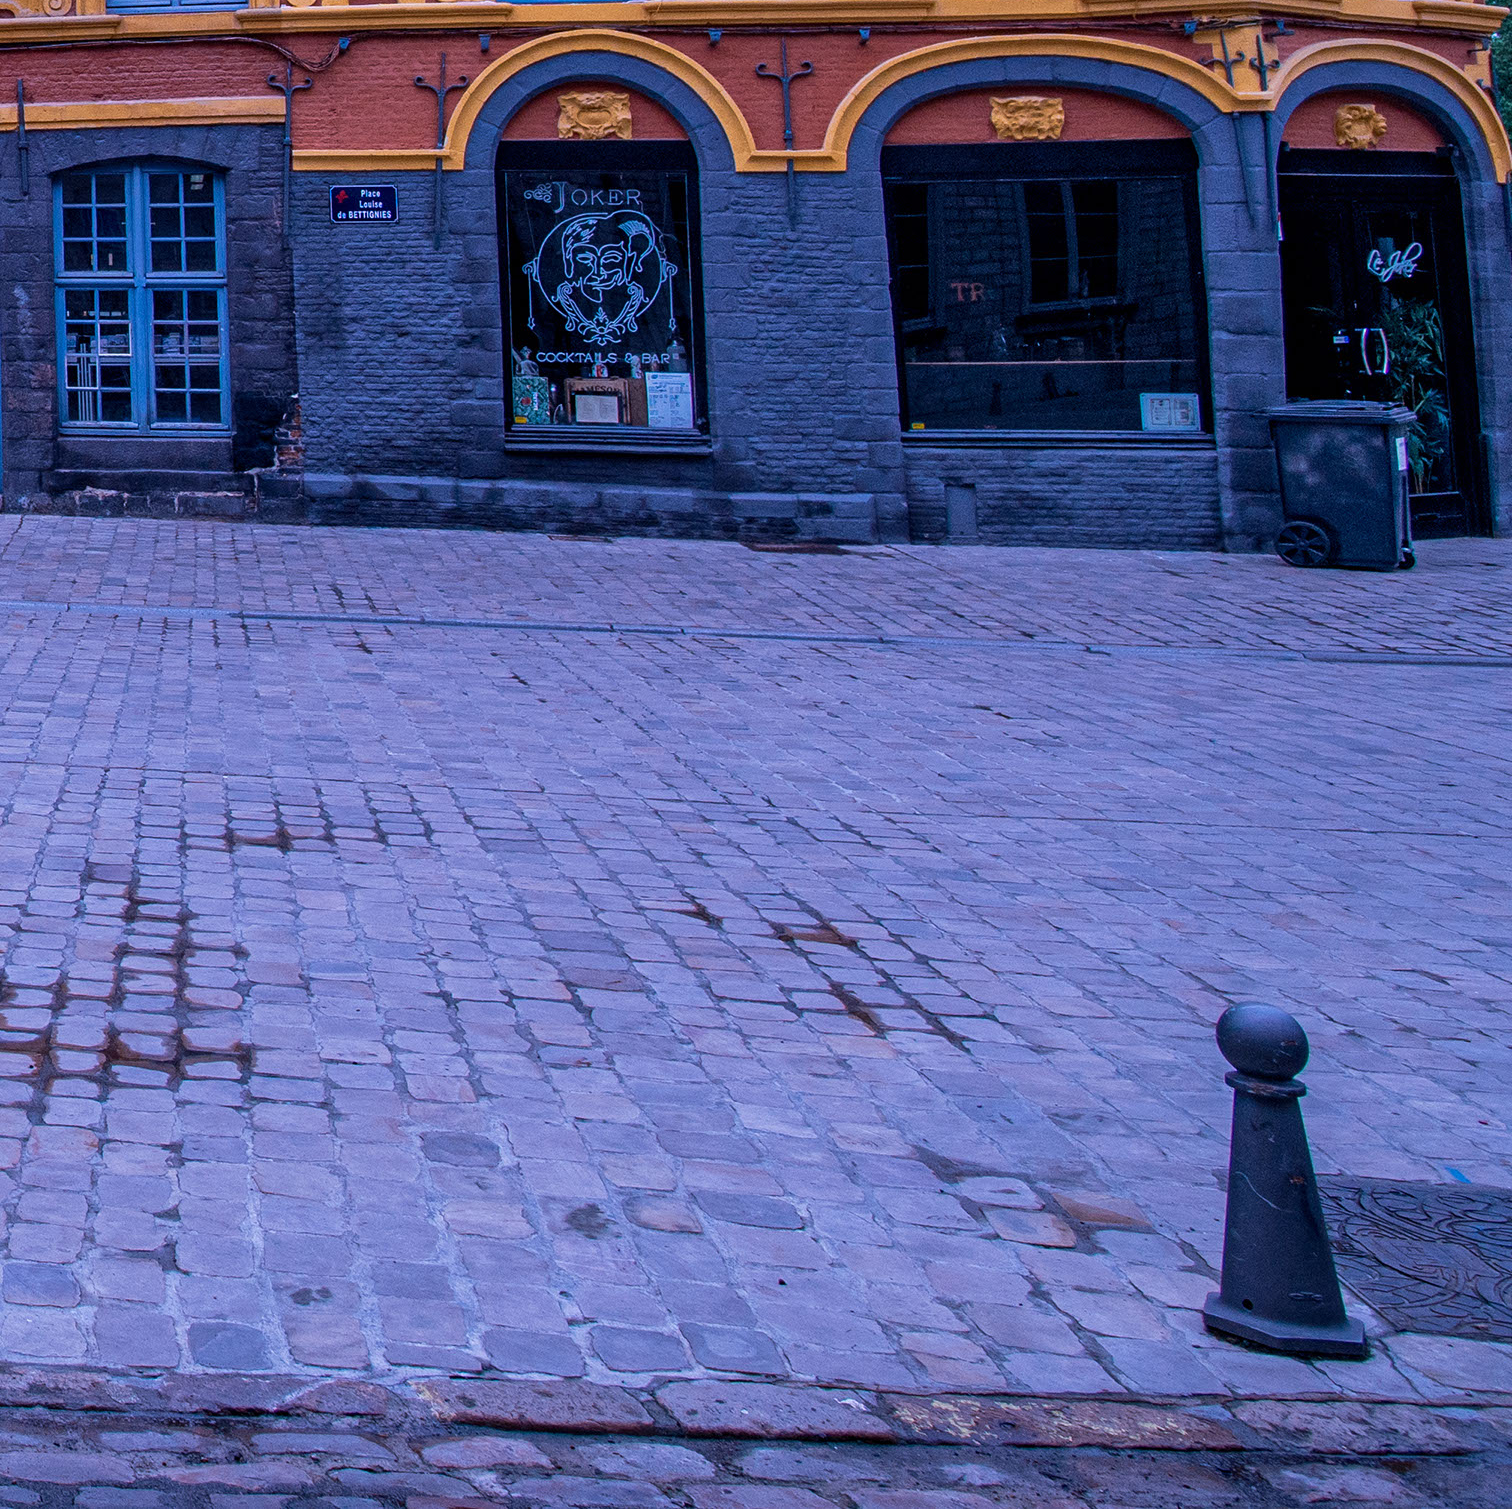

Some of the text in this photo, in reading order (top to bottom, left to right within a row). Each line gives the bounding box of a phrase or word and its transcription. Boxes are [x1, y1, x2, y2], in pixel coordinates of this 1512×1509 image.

[360, 189, 381, 198] Place
[552, 181, 641, 213] JOKER
[359, 199, 383, 209] Louise
[337, 210, 392, 219] de BETTIGNIES
[536, 352, 618, 364] COCKTAILS
[641, 352, 671, 364] BAR
